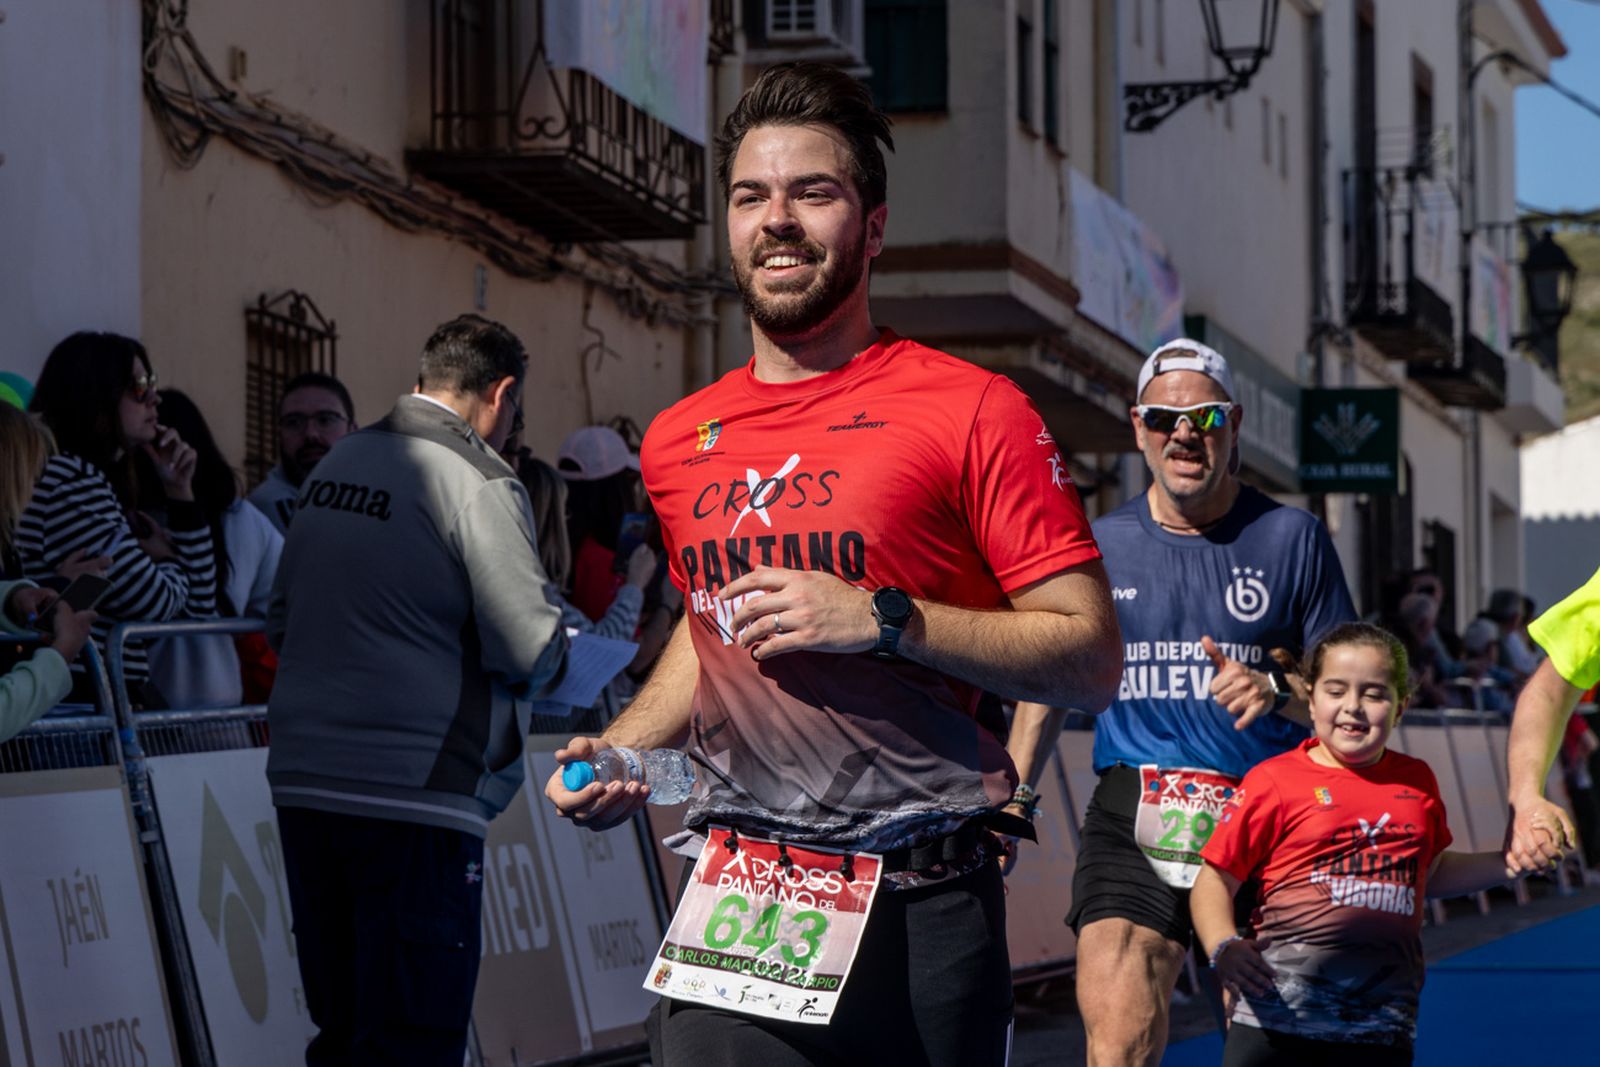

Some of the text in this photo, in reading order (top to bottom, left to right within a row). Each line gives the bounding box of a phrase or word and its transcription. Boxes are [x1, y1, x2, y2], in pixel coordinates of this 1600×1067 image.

[693, 470, 841, 520] CROSS
[682, 530, 866, 593] PANTANO
[691, 588, 715, 614] DEL
[1154, 641, 1263, 664] DEPOTIVO
[715, 873, 815, 911] PANTANO
[722, 849, 844, 894] X CROSS
[46, 867, 110, 969] JAÉN
[703, 893, 828, 968] 643
[665, 945, 719, 967] CARLOS
